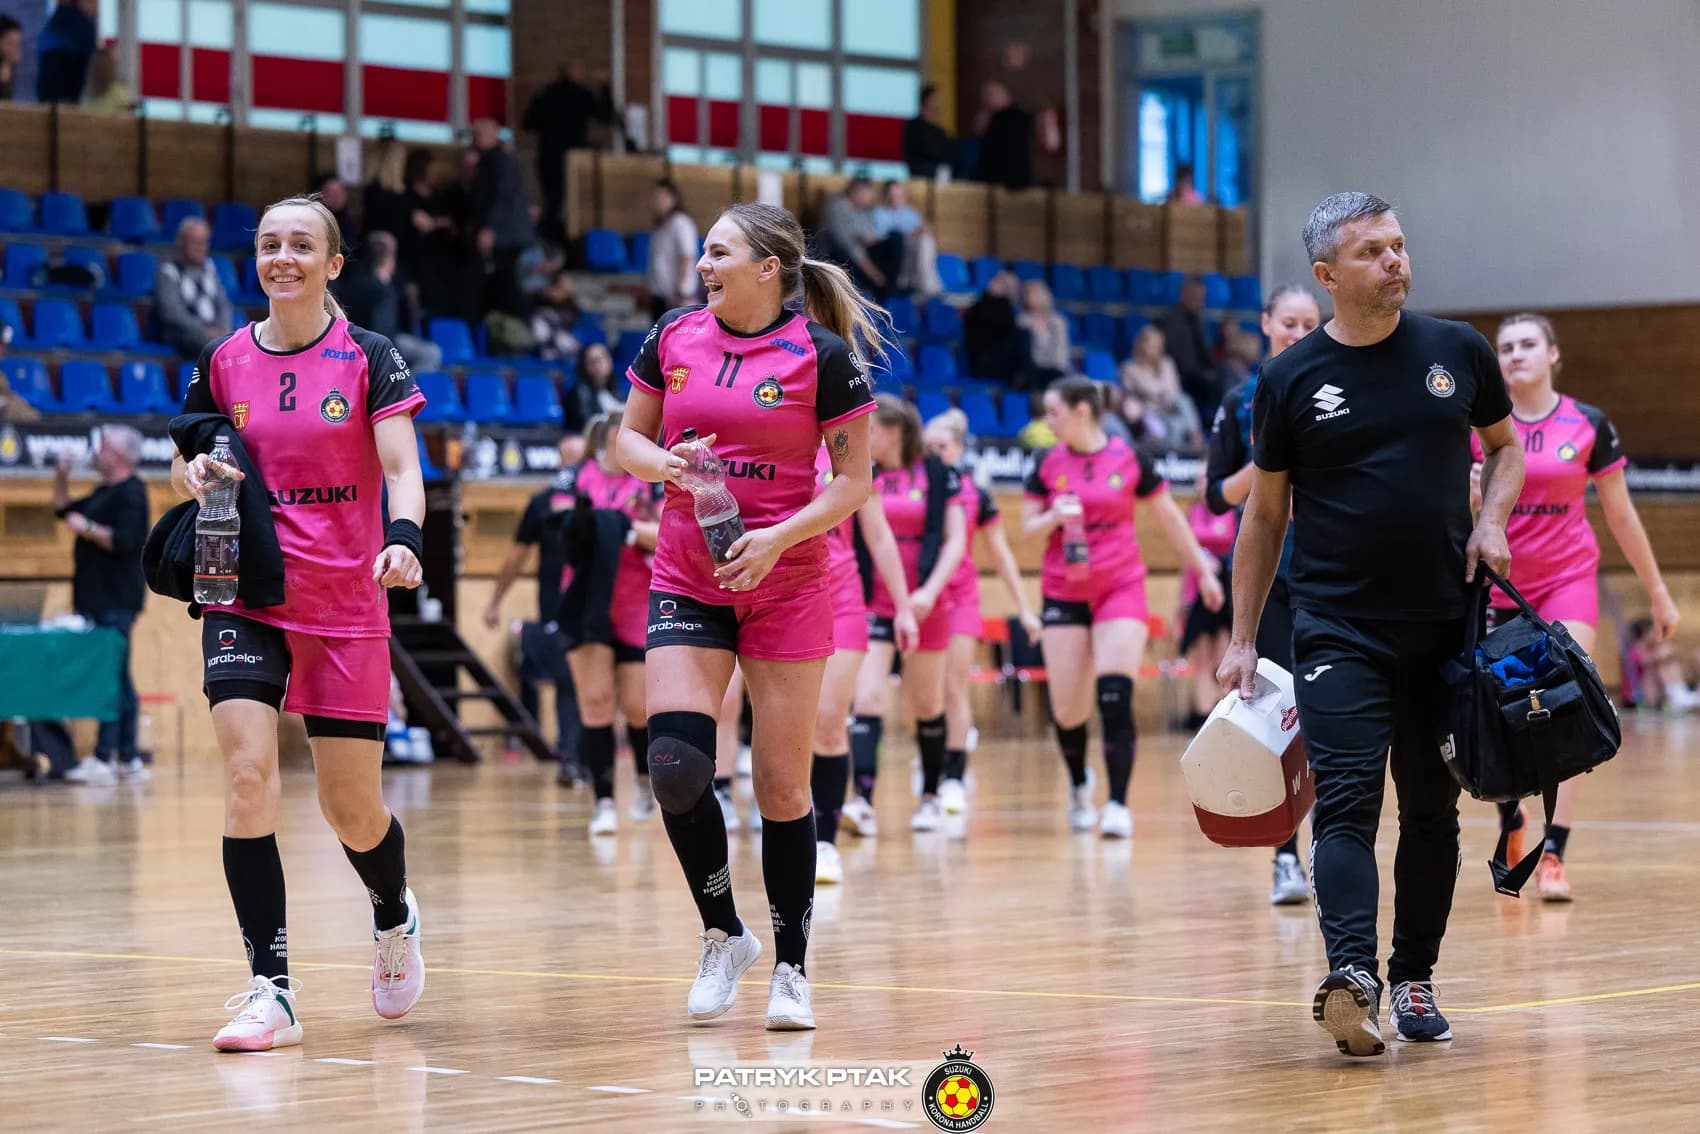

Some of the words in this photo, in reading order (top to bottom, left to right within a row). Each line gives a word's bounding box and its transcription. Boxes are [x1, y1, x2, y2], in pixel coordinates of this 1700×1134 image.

[714, 351, 744, 388] 11
[279, 372, 297, 412] 2
[1315, 407, 1350, 422] SUZUKI
[1525, 429, 1544, 453] 10
